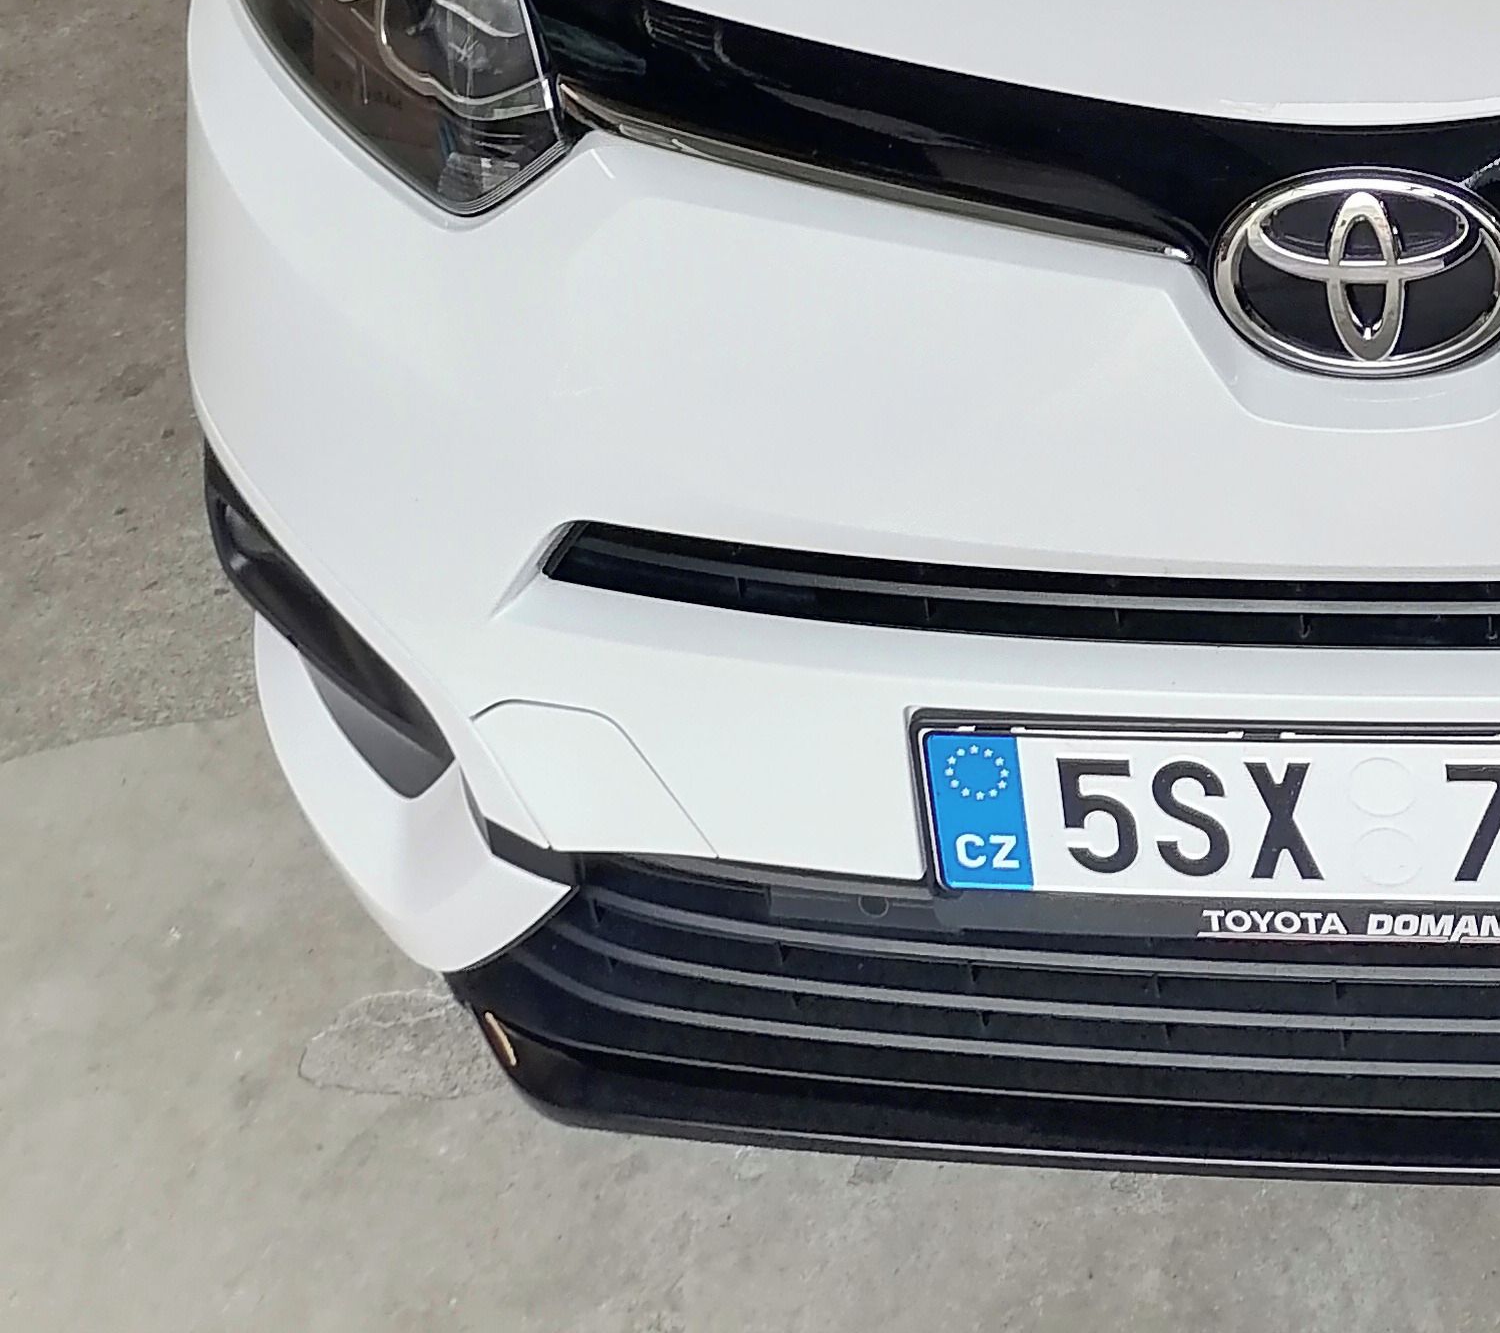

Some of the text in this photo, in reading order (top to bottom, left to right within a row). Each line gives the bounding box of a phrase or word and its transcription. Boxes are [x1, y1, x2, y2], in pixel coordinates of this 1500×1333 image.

[1055, 756, 1326, 881] 5SX
[956, 833, 1020, 868] CZ
[1201, 909, 1348, 935] TOYOTA
